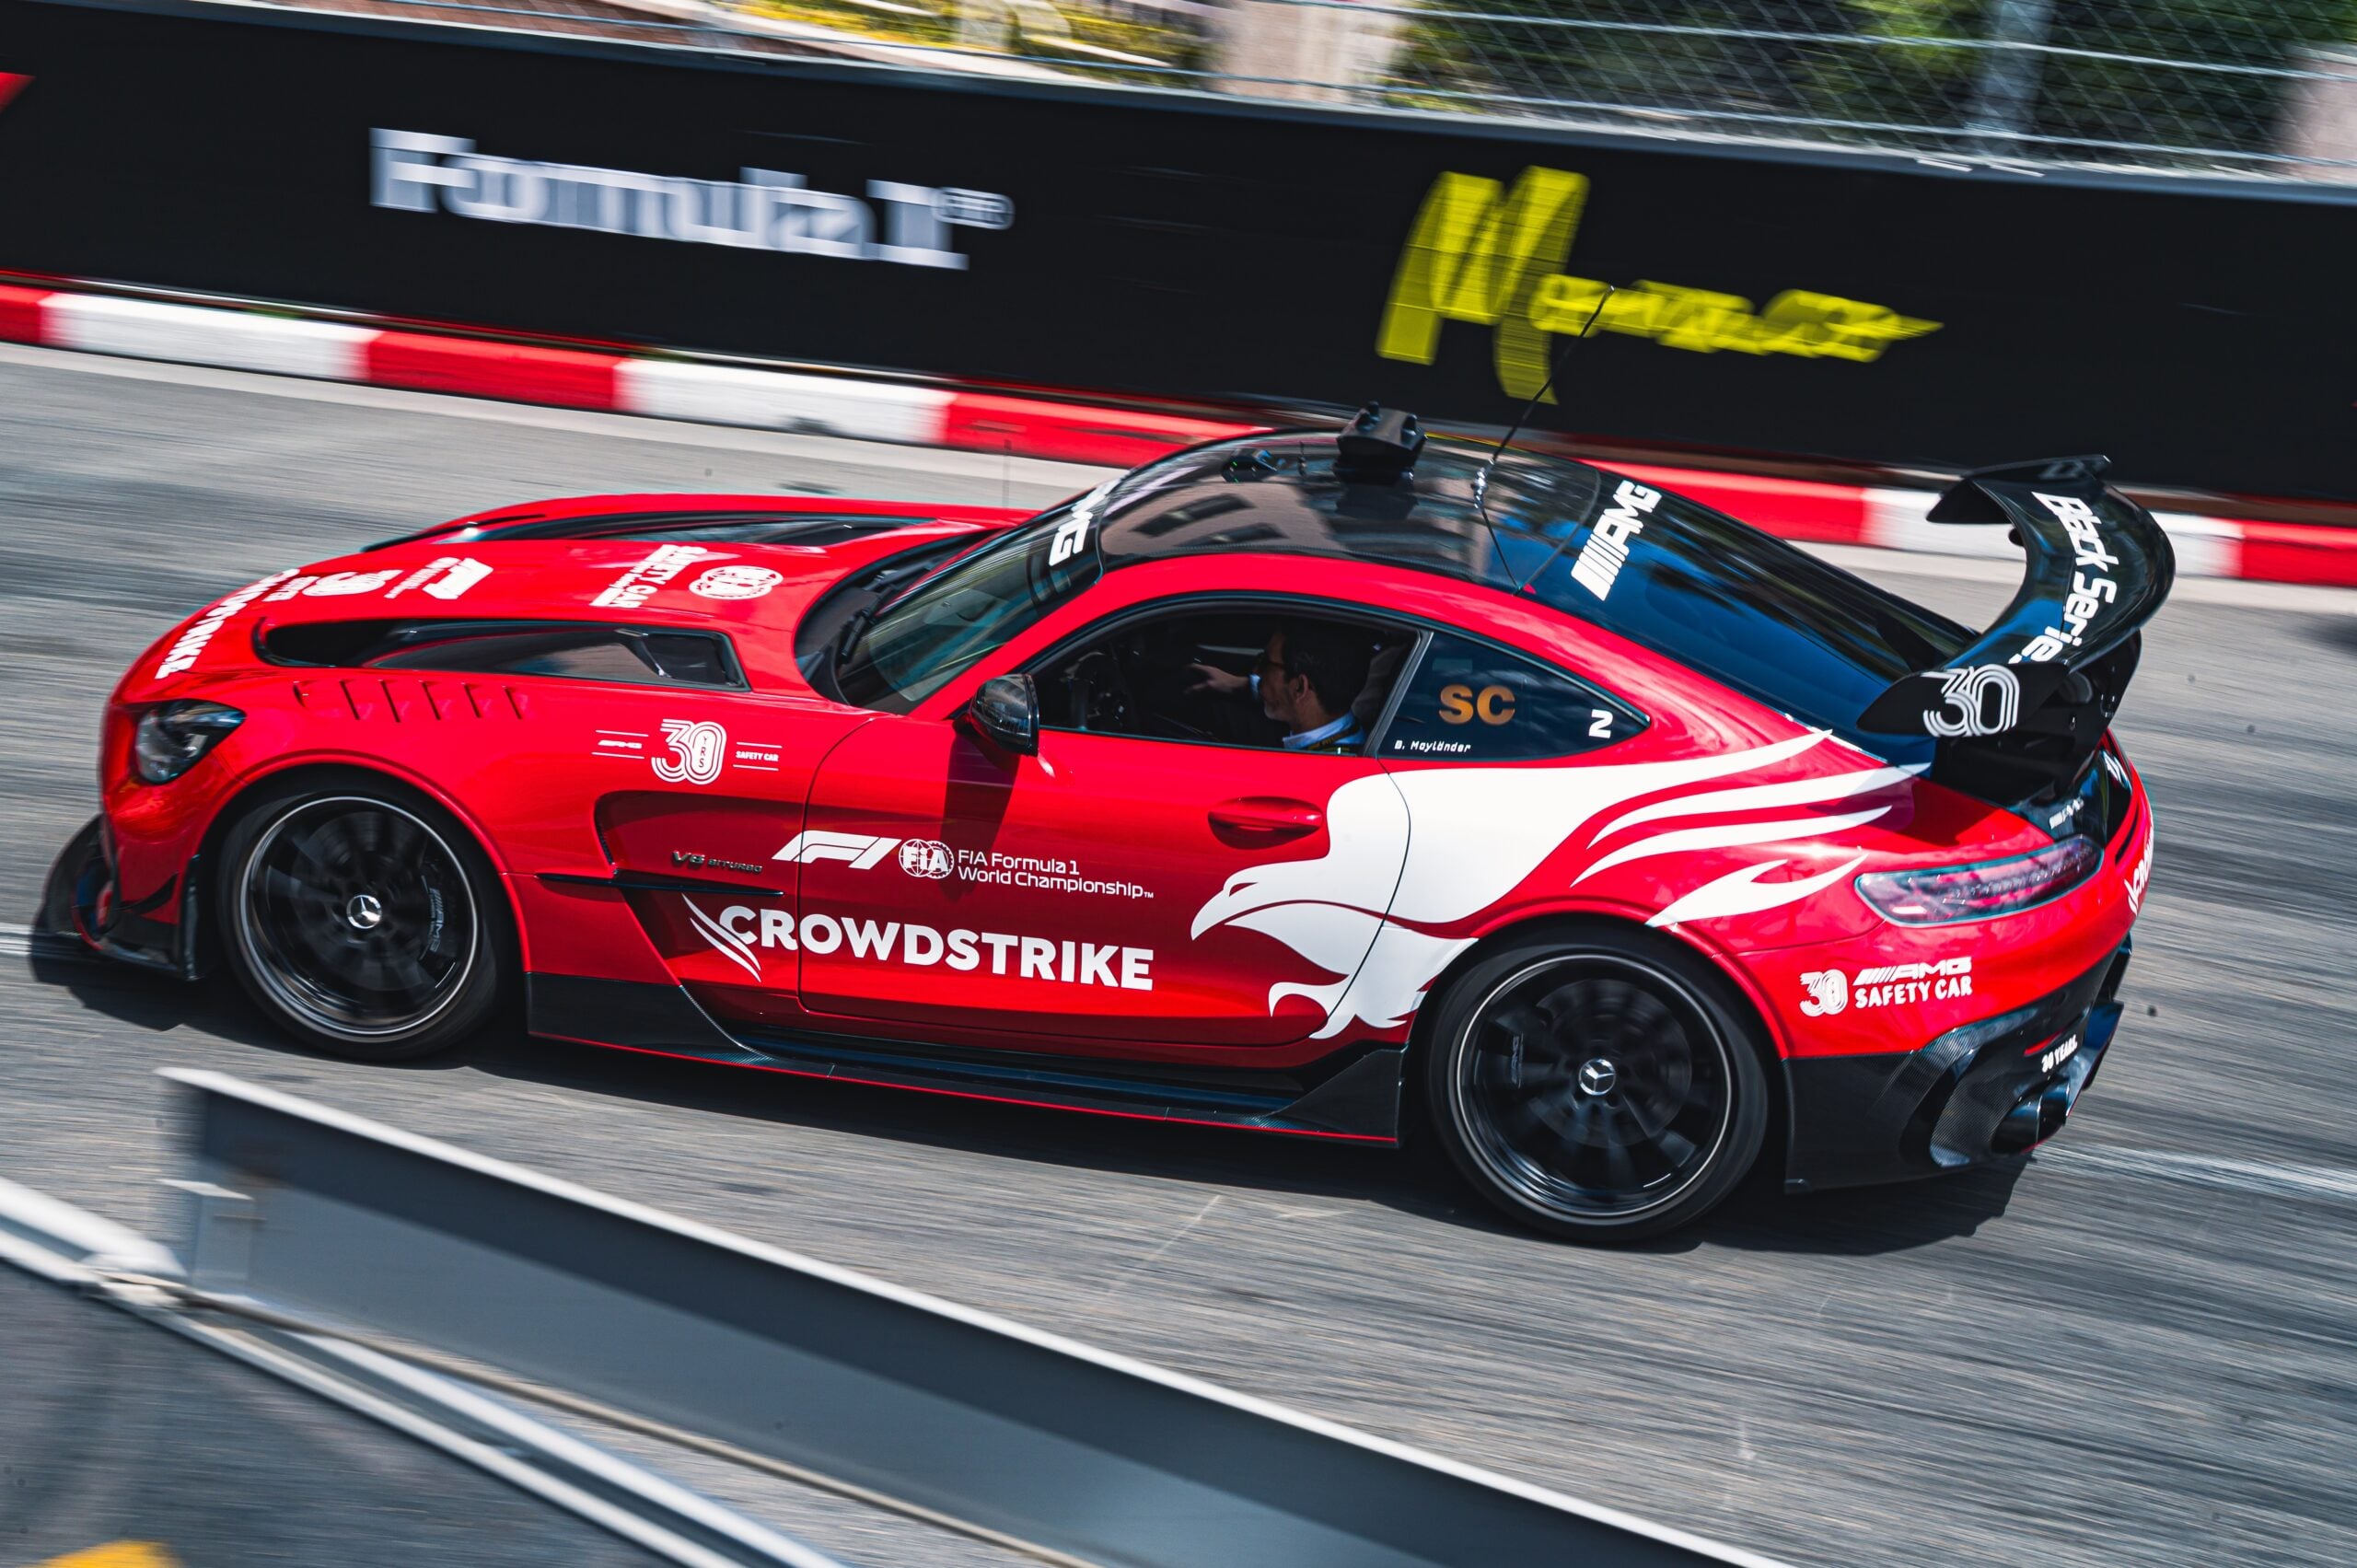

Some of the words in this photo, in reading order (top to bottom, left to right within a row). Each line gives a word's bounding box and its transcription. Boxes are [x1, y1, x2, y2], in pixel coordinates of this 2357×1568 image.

[369, 127, 877, 260] Formula
[2032, 491, 2119, 572] Black
[1438, 683, 1515, 726] SC
[1921, 663, 2020, 737] 30
[1588, 708, 1614, 739] 2
[651, 718, 727, 785] 30
[736, 750, 763, 761] SAFETY
[763, 753, 779, 762] CAR
[772, 830, 902, 869] F1
[958, 850, 988, 866] FIA
[991, 853, 1067, 875] Formula
[1069, 860, 1080, 876] 1
[958, 865, 1012, 885] World
[719, 904, 1155, 991] CROWDSTRIKE
[1852, 956, 1972, 986] AMG
[1854, 981, 1932, 1008] SAFETY
[1934, 975, 1973, 1000] CAR
[1799, 969, 1848, 1016] 30
